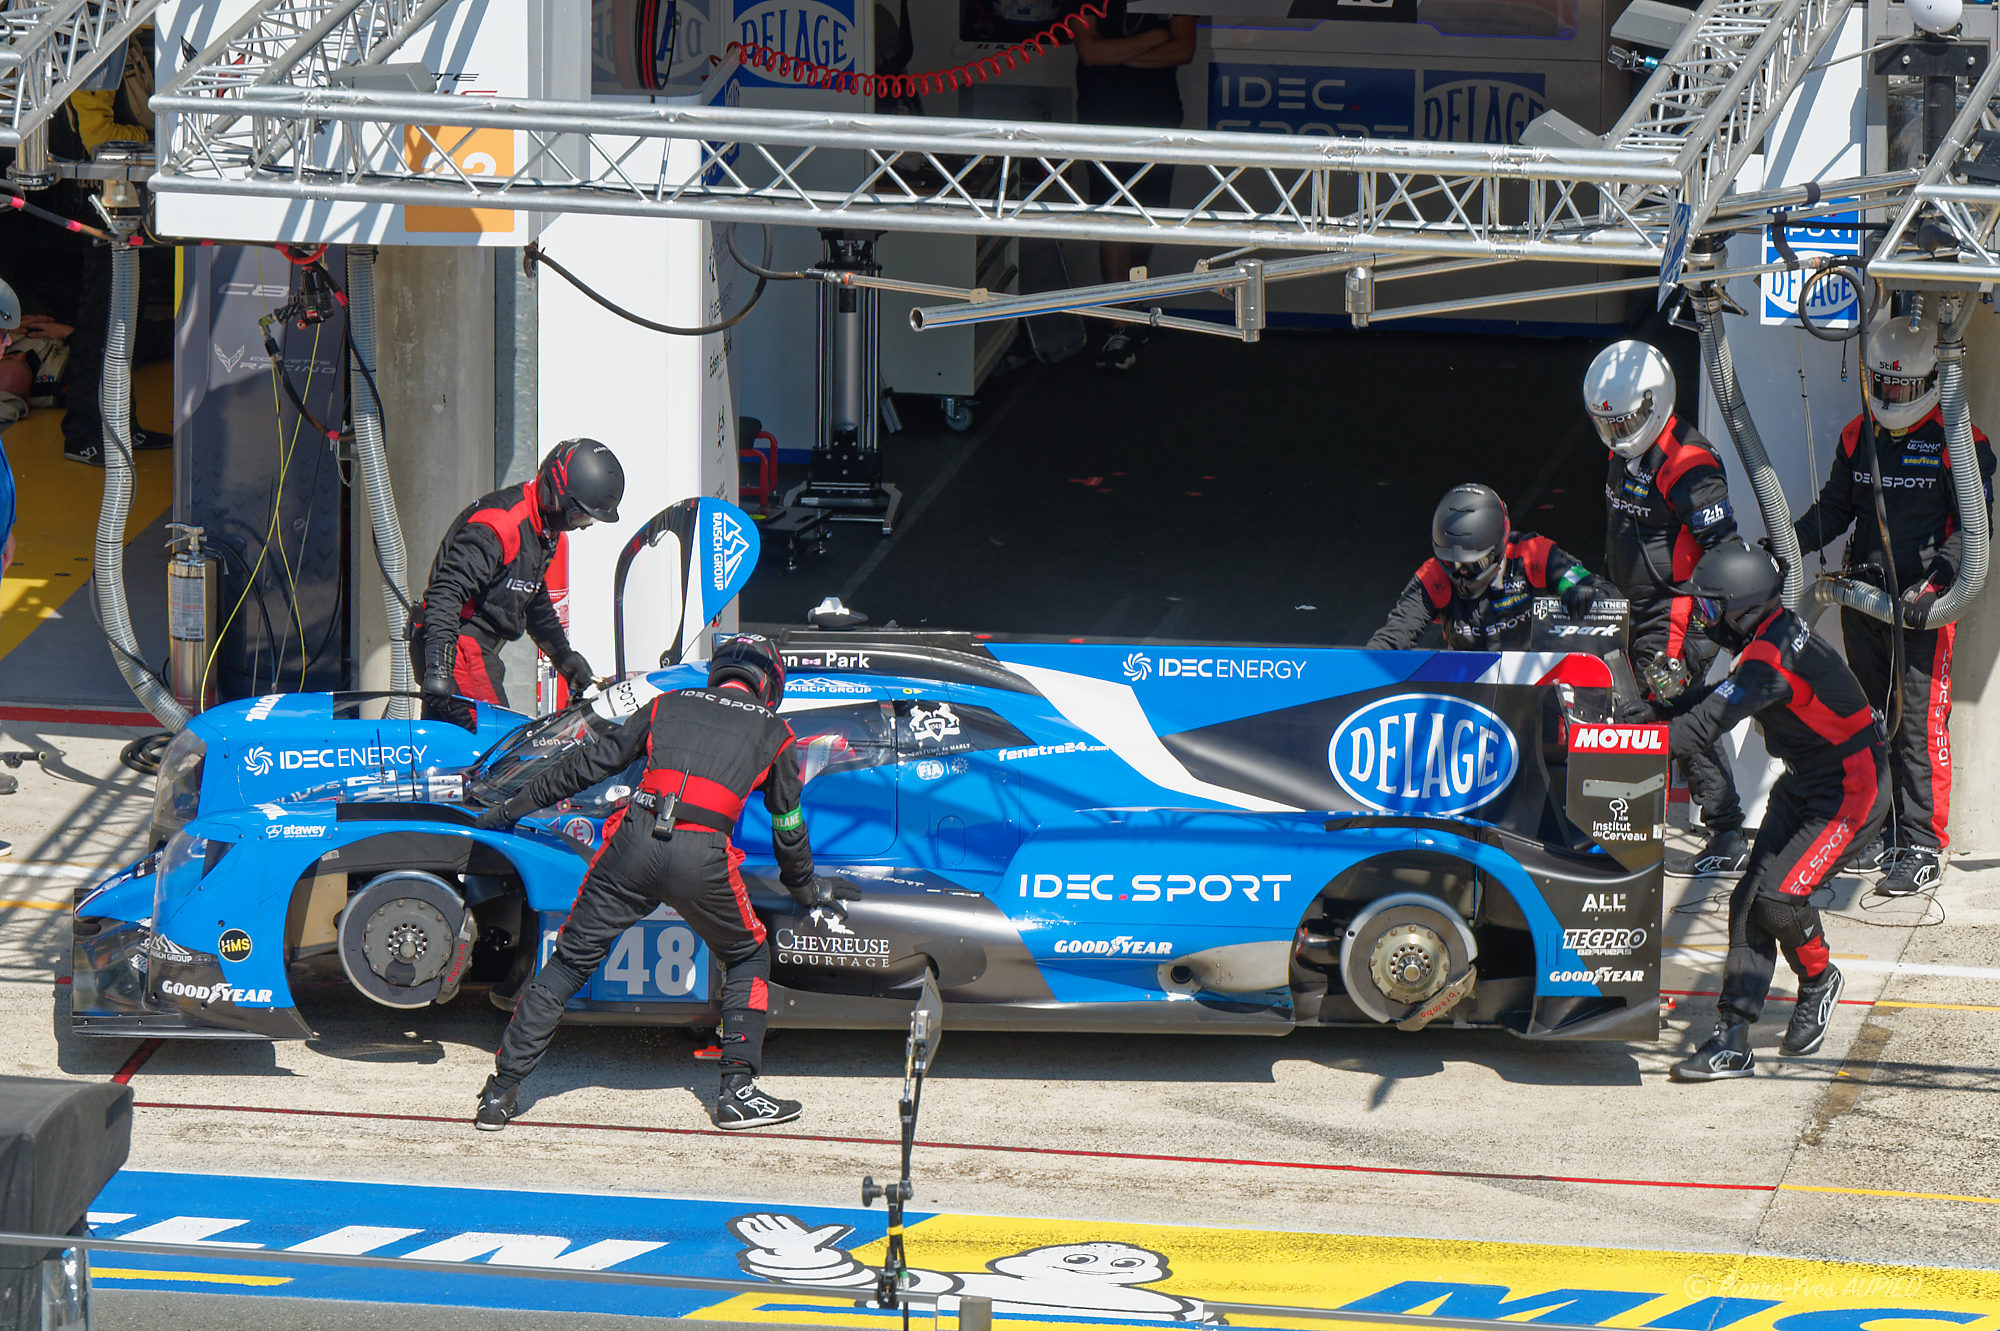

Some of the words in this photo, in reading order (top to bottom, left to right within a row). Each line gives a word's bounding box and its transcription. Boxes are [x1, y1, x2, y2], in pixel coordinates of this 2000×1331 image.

[741, 10, 848, 68] DELAGE
[1702, 504, 1724, 523] 24h
[712, 512, 723, 551] RAISCH
[713, 552, 724, 591] GROUP
[1591, 601, 1628, 609] ARTNER
[1548, 624, 1621, 638] spark
[825, 652, 869, 668] Park
[828, 686, 872, 694] GROUP
[680, 690, 774, 718] IDEC.SPORT
[532, 737, 561, 747] Eden
[1575, 728, 1662, 749] MOTUL
[1349, 712, 1499, 799] DELAGE
[283, 824, 327, 837] atawey
[1592, 821, 1632, 832] Institut
[1602, 830, 1647, 842] Cerveau
[1019, 874, 1291, 902] IDEC.SPORT
[220, 937, 250, 953] HMS
[1054, 937, 1173, 956] GOODYEAR
[1562, 928, 1647, 949] TECPRO
[167, 954, 193, 963] GROUP
[604, 926, 697, 996] 48
[778, 953, 890, 968] COURTAGE
[1549, 968, 1645, 984] GOODYEAR
[161, 980, 273, 1003] GOODYEAR
